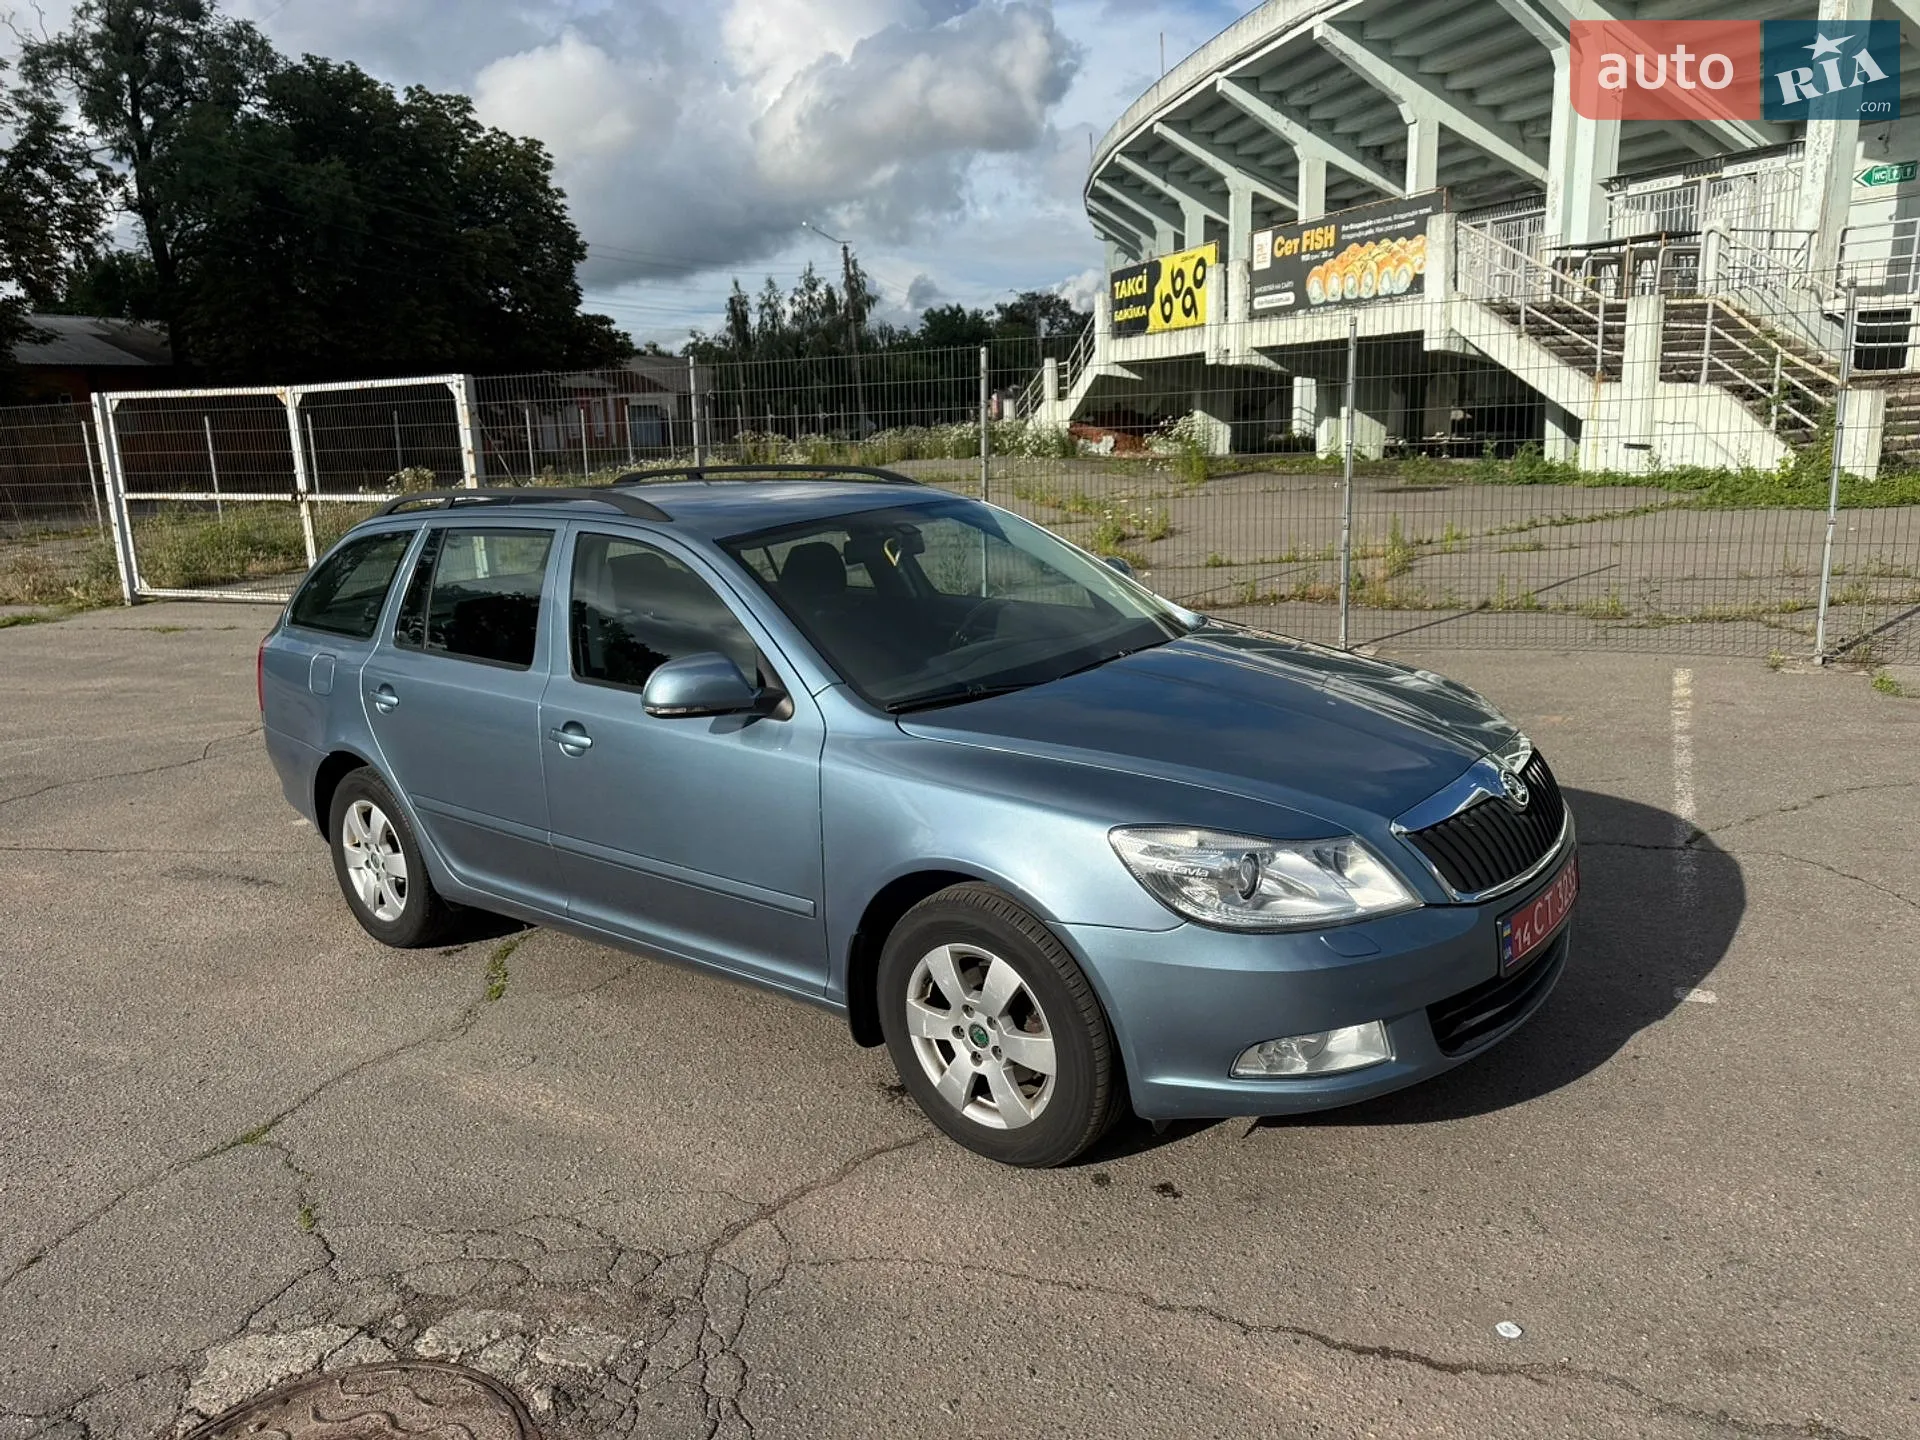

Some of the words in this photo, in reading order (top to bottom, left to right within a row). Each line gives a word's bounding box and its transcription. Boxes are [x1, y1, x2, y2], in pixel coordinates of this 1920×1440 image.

[1874, 170, 1887, 181] WC
[1301, 224, 1336, 253] FISH
[1515, 922, 1531, 952] 14
